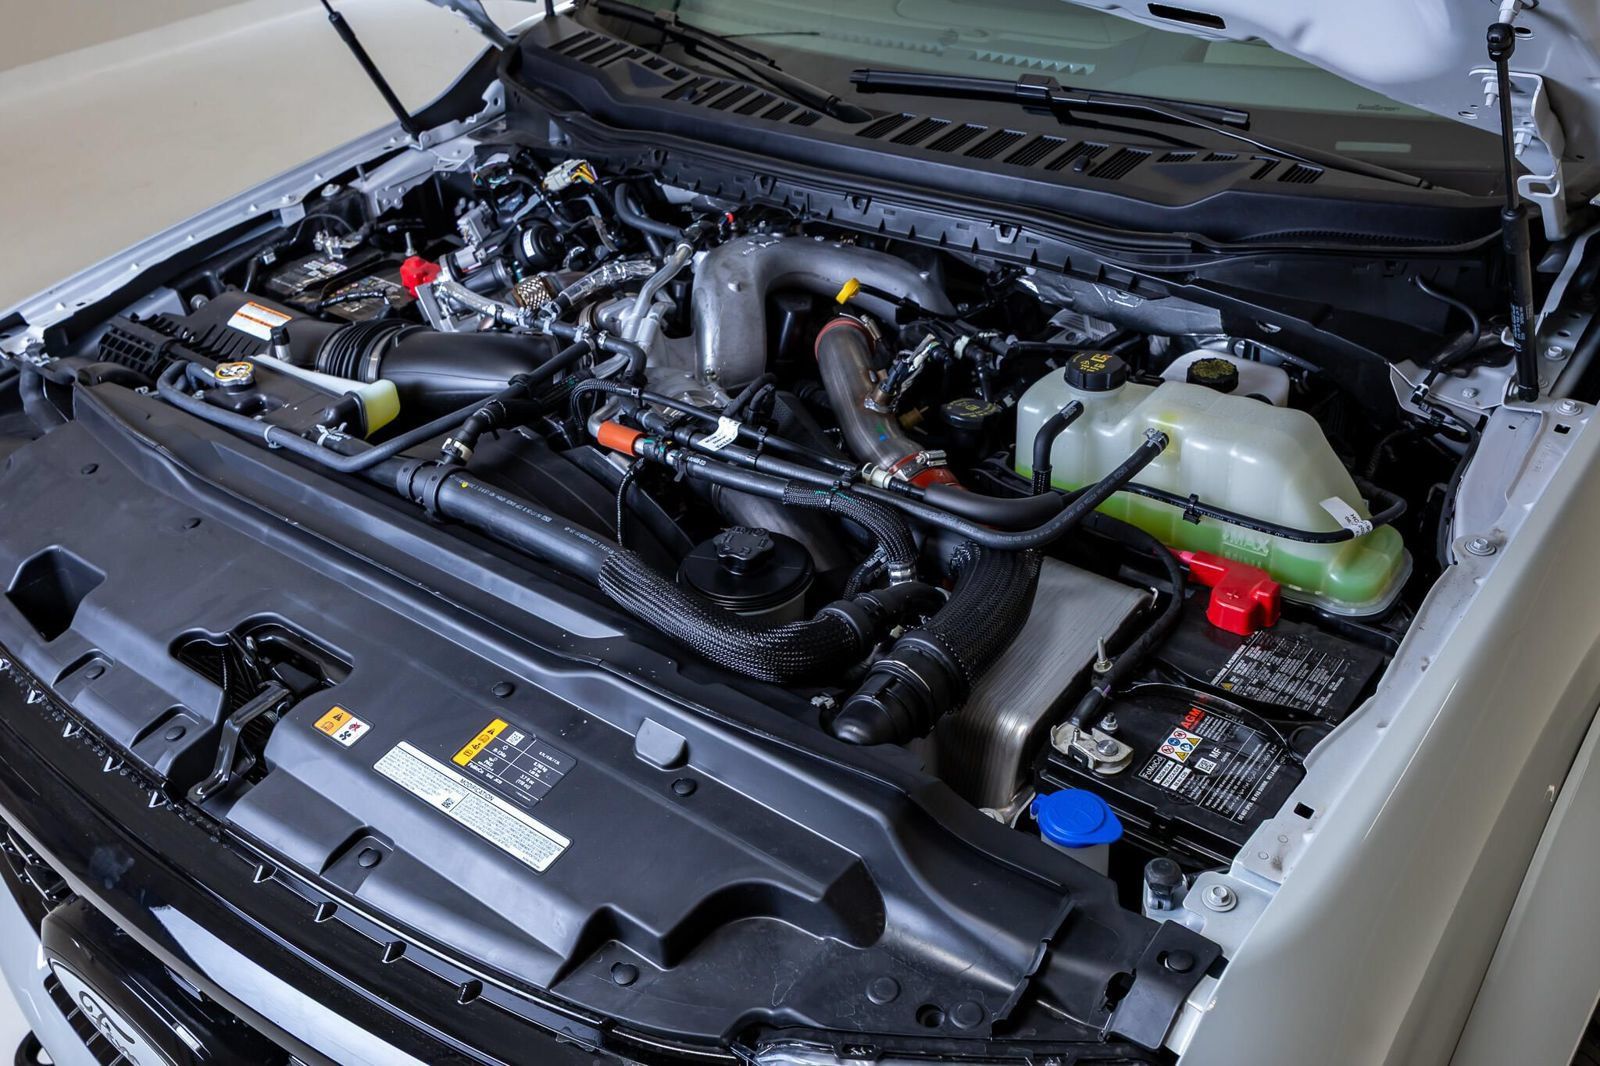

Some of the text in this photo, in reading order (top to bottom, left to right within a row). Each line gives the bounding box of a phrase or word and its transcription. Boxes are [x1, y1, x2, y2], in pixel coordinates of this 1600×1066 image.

[1181, 707, 1203, 729] AGM
[1142, 757, 1163, 780] FoMoCo
[460, 778, 495, 802] MODIFICATION
